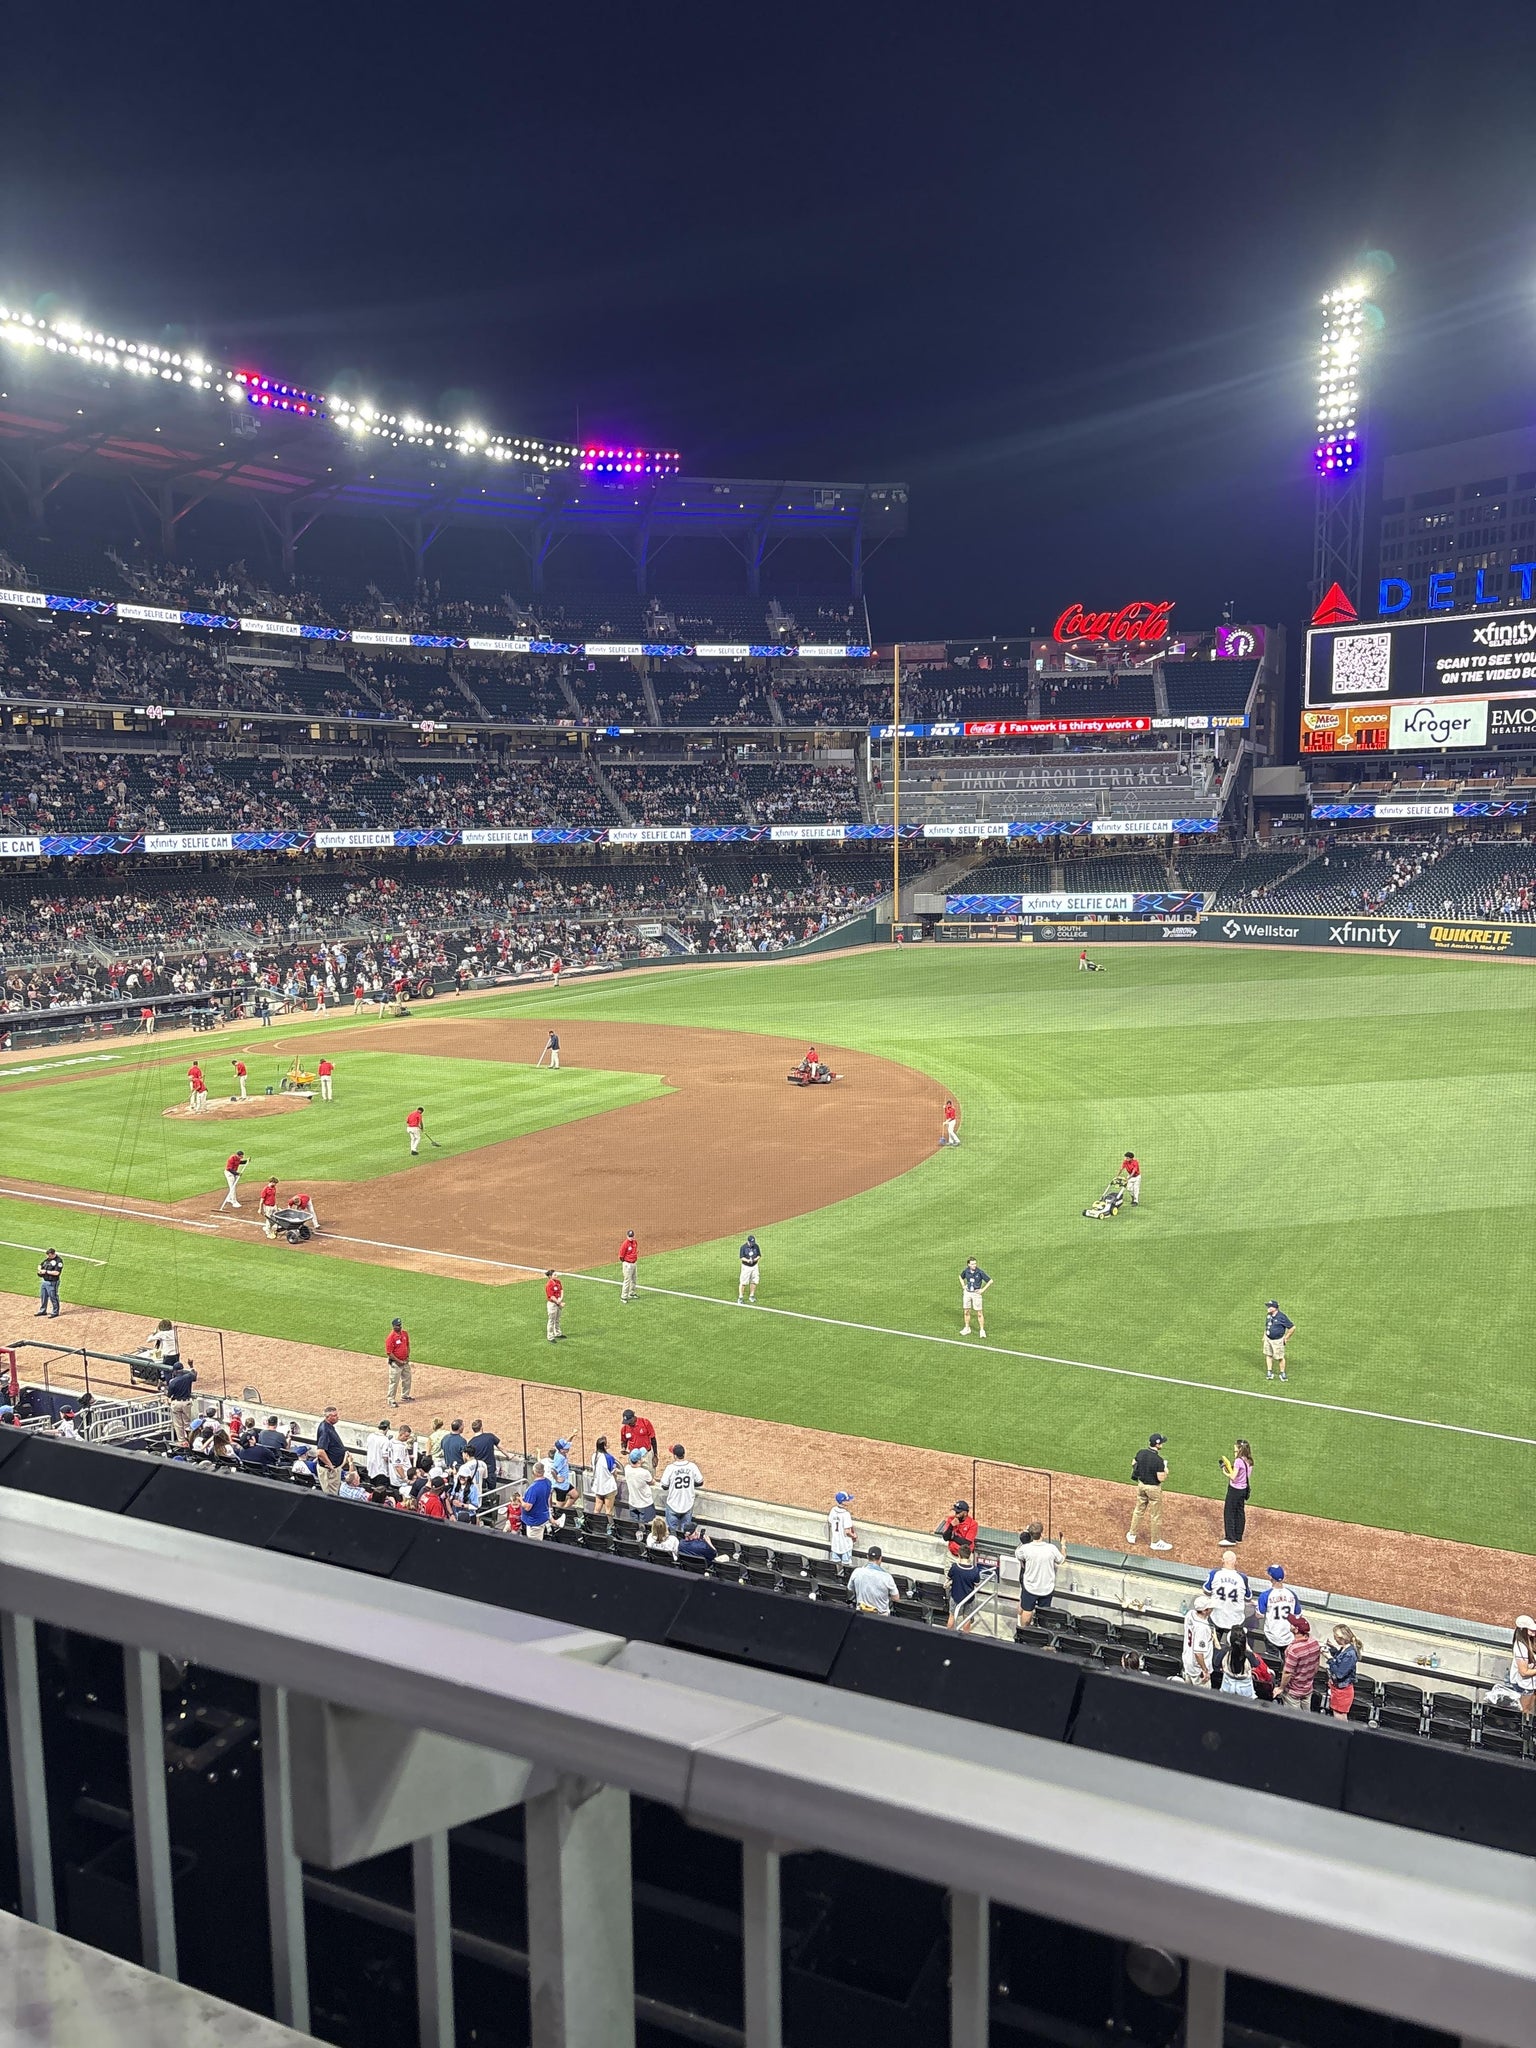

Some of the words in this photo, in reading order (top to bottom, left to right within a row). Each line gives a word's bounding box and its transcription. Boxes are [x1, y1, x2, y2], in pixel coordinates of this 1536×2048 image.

[1379, 562, 1536, 614] DELT
[26, 595, 42, 604] CAM
[143, 610, 163, 619] SELFIE
[164, 612, 178, 620] CAM
[1053, 601, 1176, 643] Coca-Cola
[266, 624, 285, 632] SELFIE
[286, 626, 298, 634] CAM
[1473, 620, 1536, 645] xfinity
[1436, 657, 1470, 670] SCAN
[1471, 656, 1488, 668] TO
[1488, 654, 1513, 667] SEE
[1441, 672, 1460, 684] ON
[1461, 670, 1484, 682] THE
[1486, 667, 1521, 680] VIDEO
[1491, 708, 1536, 726] EMO
[1010, 723, 1029, 732] Fan
[1030, 723, 1055, 731] work
[1058, 722, 1067, 731] is
[1069, 720, 1104, 731] thirsty
[1106, 720, 1132, 729] work
[1404, 708, 1471, 743] Kroger
[1304, 744, 1333, 752] MILLION
[1357, 742, 1387, 750] MILLION
[961, 771, 1007, 789] HANK
[1016, 769, 1076, 788] AARON
[1086, 766, 1173, 787] TERRACE
[1406, 806, 1431, 815] SELFIE
[1433, 805, 1450, 814] CAM
[775, 828, 799, 838] xfinity
[801, 828, 825, 837] SELFIE
[826, 828, 841, 837] CAM
[929, 824, 955, 835] xfinity
[958, 825, 985, 835] SELFIE
[987, 825, 1004, 834] CAM
[1097, 822, 1122, 833] xfinity
[1124, 822, 1150, 832] SELFIE
[1152, 822, 1168, 831] CAM
[320, 834, 345, 846] xfinity
[349, 835, 373, 845] SELFIE
[375, 834, 390, 844] CAM
[466, 832, 485, 842] xfinity
[487, 832, 511, 841] SELFIE
[513, 832, 528, 841] CAM
[613, 830, 637, 840] xfinity
[641, 830, 668, 839] SELFIE
[670, 830, 687, 839] CAM
[12, 841, 34, 852] CAM
[150, 837, 178, 849] xfinity
[182, 837, 209, 848] SELFIE
[211, 836, 228, 847] CAM
[1027, 898, 1062, 910] xfinity
[1067, 898, 1101, 910] SELFIE
[1105, 898, 1127, 909] CAM
[1243, 924, 1299, 938] Wellstar
[1329, 922, 1401, 946] xfinity
[1430, 926, 1513, 945] QUIKRETE
[674, 1475, 690, 1489] 29
[1216, 1586, 1239, 1602] 44
[1273, 1605, 1291, 1619] 13
